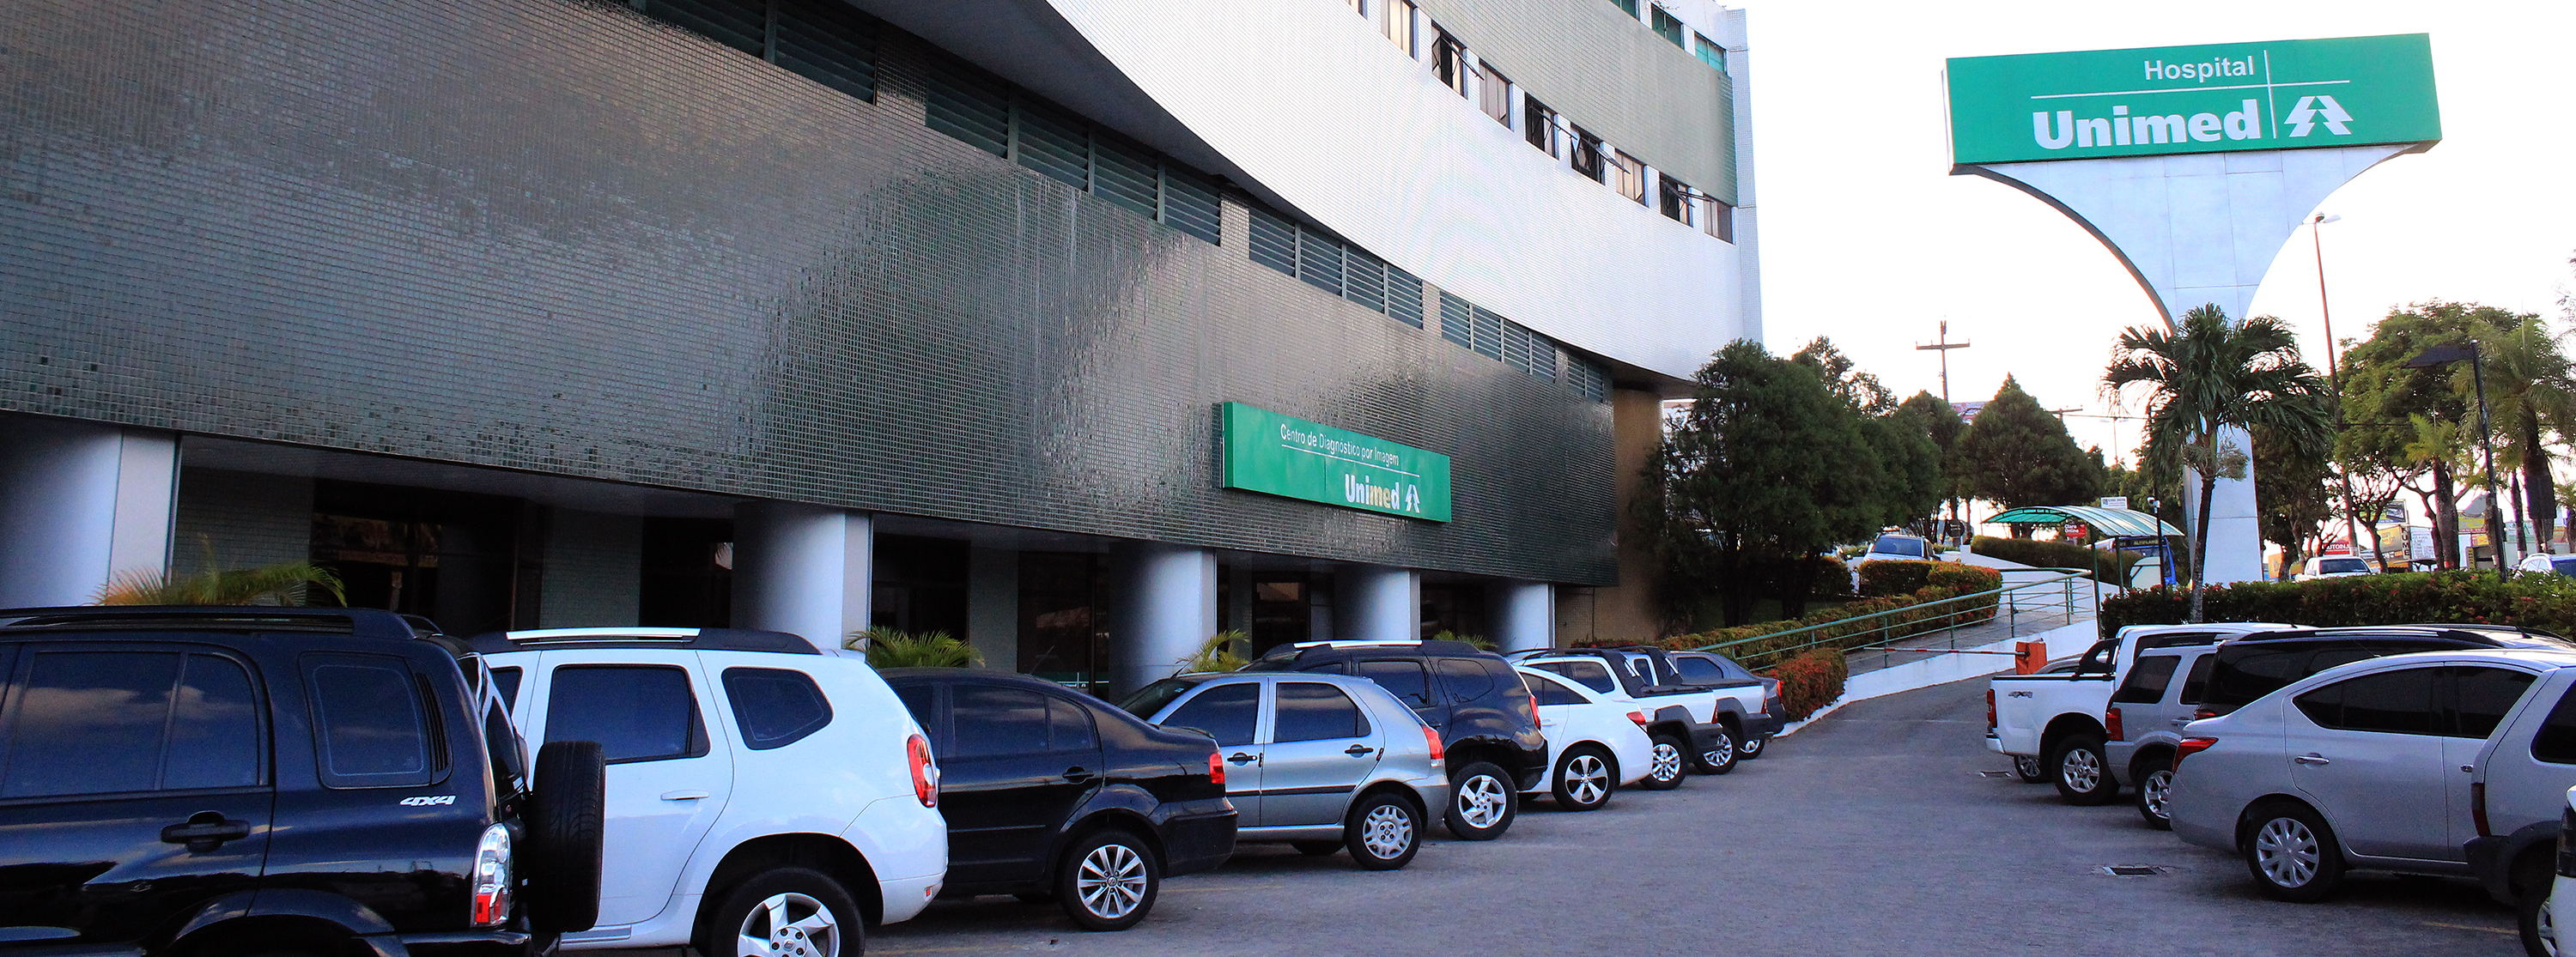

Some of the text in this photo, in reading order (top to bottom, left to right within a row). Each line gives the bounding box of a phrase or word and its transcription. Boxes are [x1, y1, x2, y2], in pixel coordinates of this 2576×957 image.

[2144, 55, 2255, 83] Hospital
[2032, 99, 2262, 150] Unimed
[1280, 423, 1400, 468] Centro de Diagnóstico por Imagem
[1345, 473, 1400, 511] Unimed
